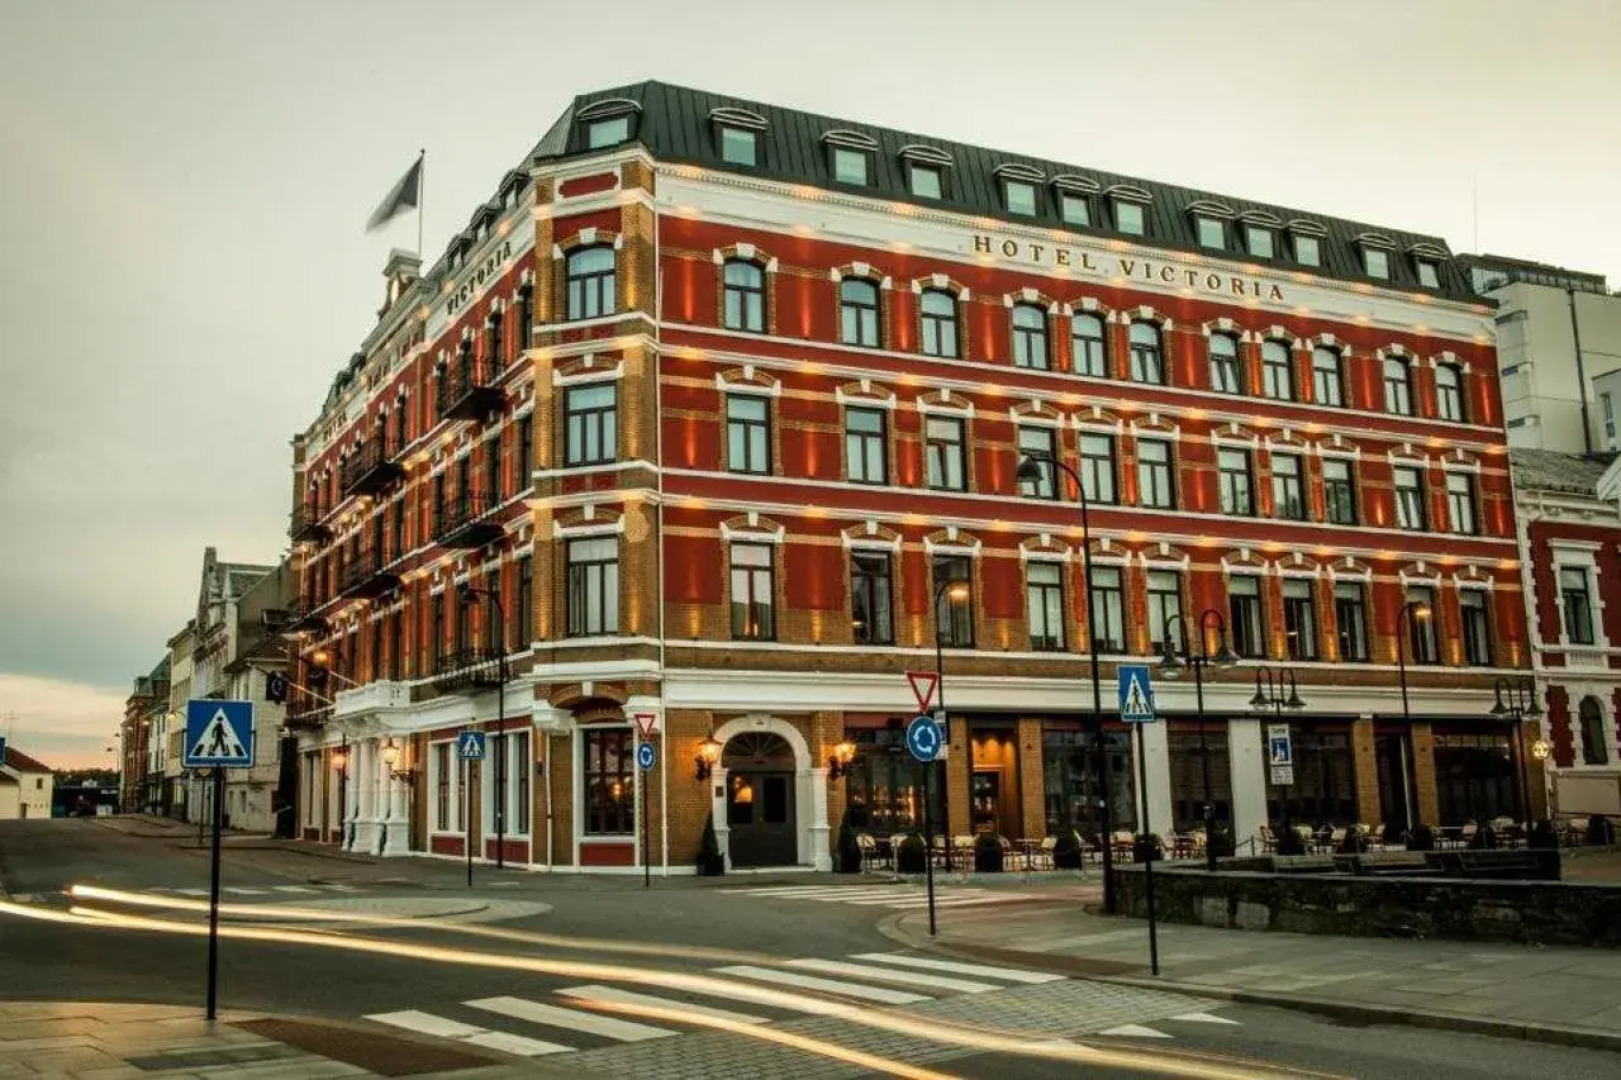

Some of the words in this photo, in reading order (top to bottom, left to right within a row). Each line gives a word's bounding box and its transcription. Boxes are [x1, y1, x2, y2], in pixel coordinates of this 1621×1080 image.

[447, 242, 511, 315] VICTORIA
[974, 235, 1097, 270] HOTEL
[1119, 259, 1284, 301] VICTORIA
